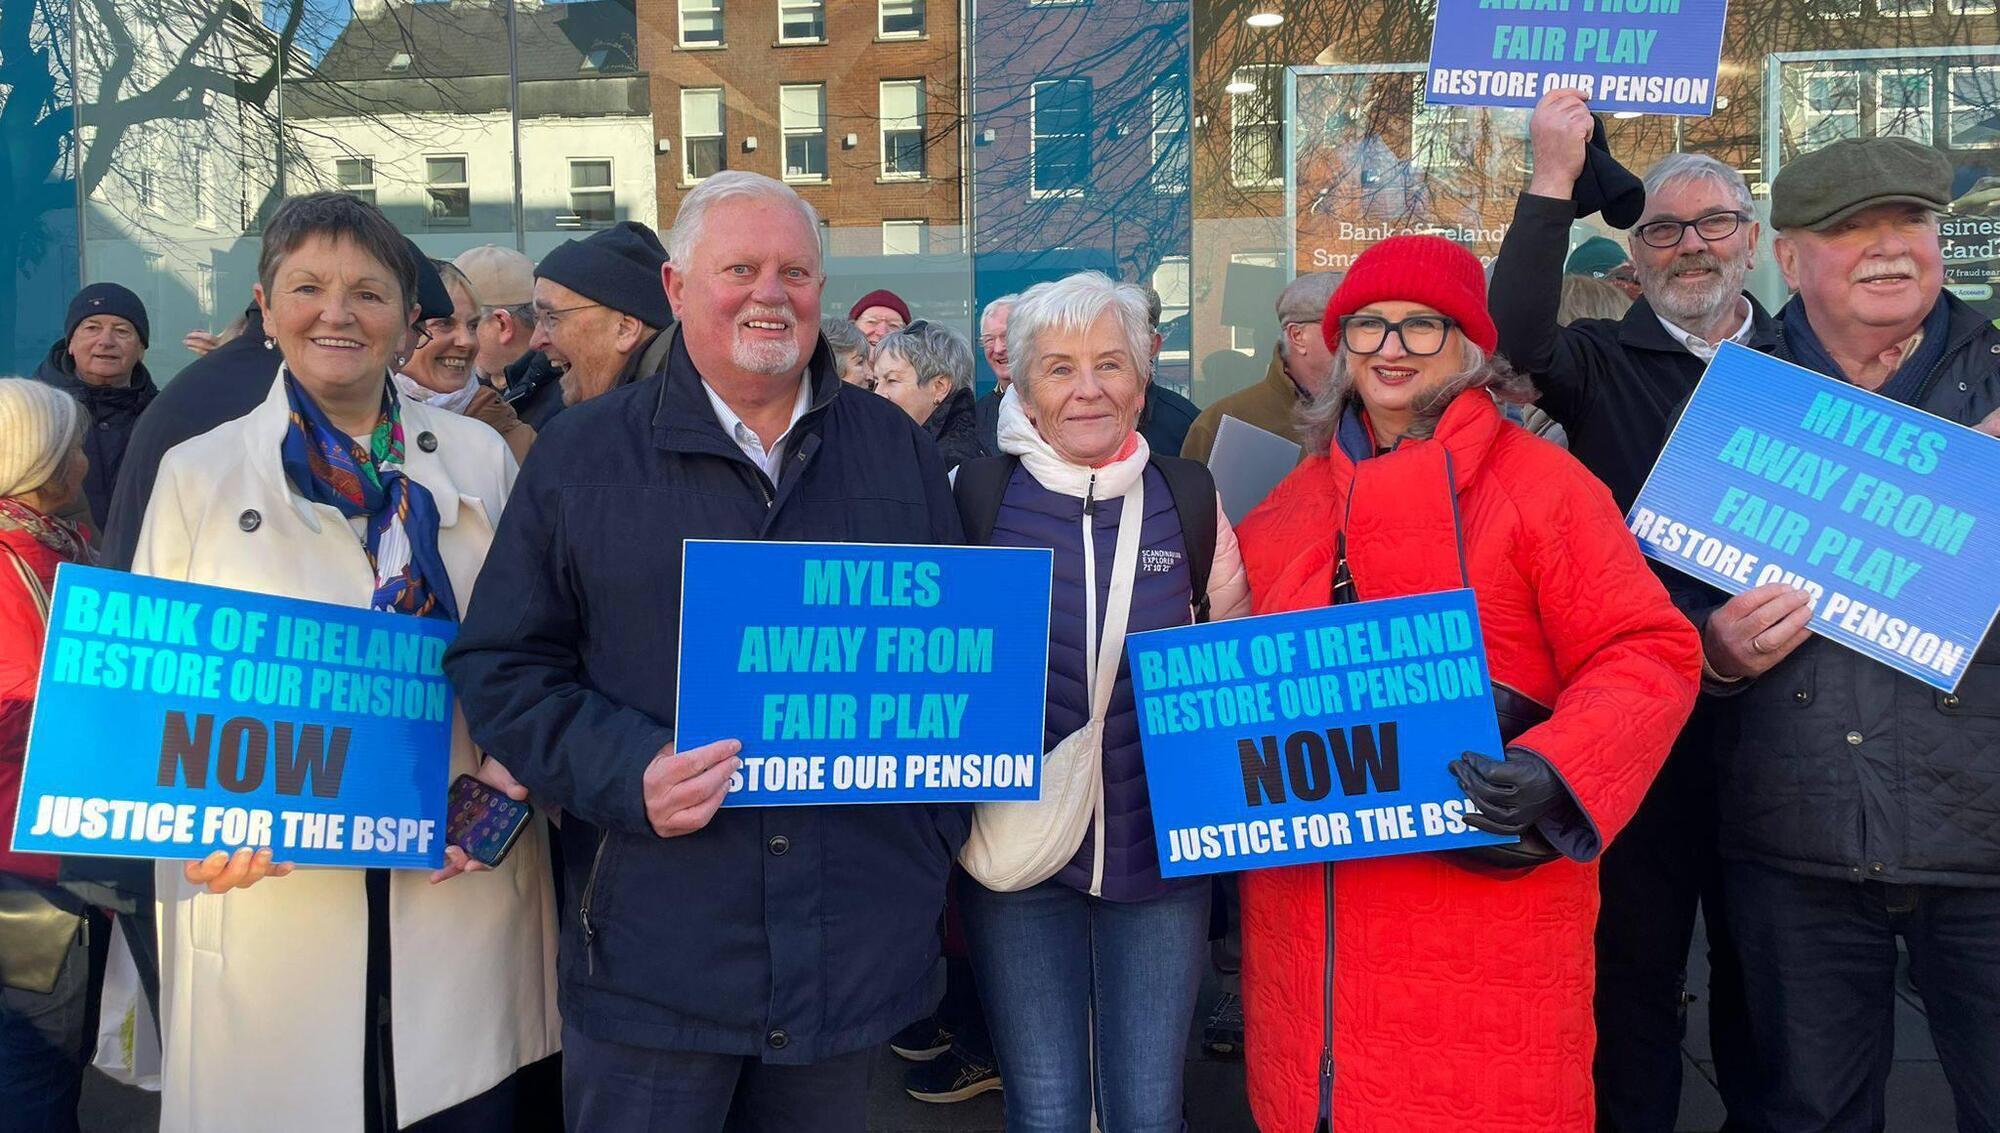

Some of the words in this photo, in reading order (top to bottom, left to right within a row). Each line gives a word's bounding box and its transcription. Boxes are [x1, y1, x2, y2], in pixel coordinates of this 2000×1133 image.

[1492, 25, 1568, 62] FAIR
[1573, 27, 1658, 65] PLAY
[1432, 68, 1539, 98] RESTORE
[1599, 75, 1709, 104] PENSION
[1339, 222, 1396, 241] Bank
[1956, 268, 1980, 277] fraud
[1801, 390, 1947, 475] MYLES
[1717, 426, 1849, 502] AWAY
[1840, 472, 1976, 556] FROM
[1712, 486, 1810, 556] FAIR
[1807, 526, 1923, 601] PLAY
[803, 559, 941, 608] MYLES
[1629, 507, 1759, 584] RESTORE
[1820, 592, 1965, 676] PENSION
[63, 585, 203, 646] BANK
[210, 606, 269, 654] OF
[274, 616, 448, 677] IRELAND
[737, 626, 866, 673] AWAY
[875, 627, 994, 674] FROM
[1139, 639, 1244, 691] BANK
[1250, 631, 1298, 677] OF
[1304, 608, 1474, 670] IRELAND
[53, 637, 225, 699] RESTORE
[229, 658, 302, 706] OUR
[310, 667, 447, 722] PENSION
[1144, 686, 1275, 736] RESTORE
[1280, 673, 1345, 720] OUR
[1347, 655, 1484, 713] PENSION
[762, 694, 857, 740] FAIR
[869, 694, 969, 740] PLAY
[155, 709, 352, 798] NOW
[728, 756, 825, 793] STORE
[833, 754, 897, 790] OUR
[905, 754, 1034, 790] PENSION
[1236, 721, 1401, 808] NOW
[31, 794, 196, 843] JUSTICE
[201, 806, 273, 847] FOR
[280, 811, 345, 850] THE
[352, 815, 435, 853] BSPF
[1169, 818, 1289, 863] JUSTICE
[1292, 813, 1351, 850] FOR
[1355, 804, 1418, 843] THE
